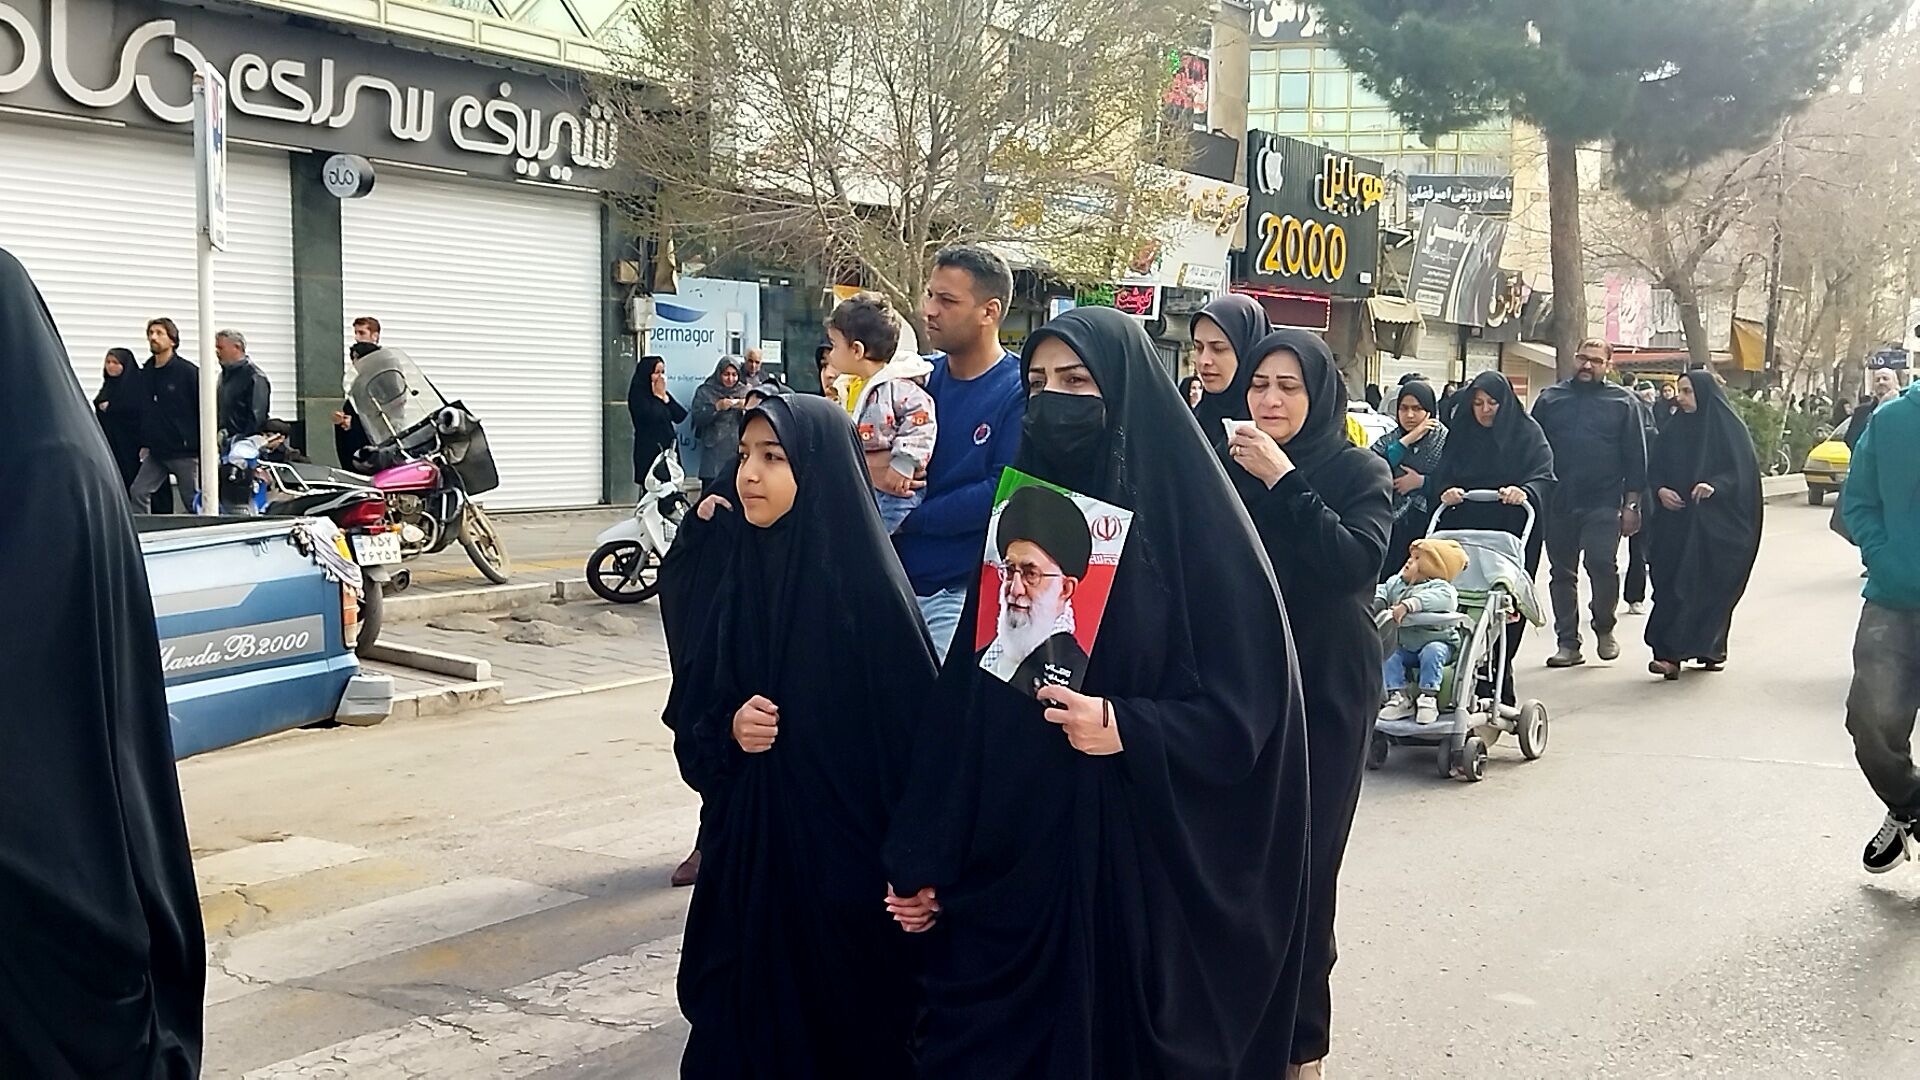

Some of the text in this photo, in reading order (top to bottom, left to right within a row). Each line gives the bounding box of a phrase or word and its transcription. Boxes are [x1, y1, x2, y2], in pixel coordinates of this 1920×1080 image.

[229, 53, 435, 142] سرای
[450, 82, 618, 181] شیرینی
[1315, 153, 1384, 216] موبایل
[1257, 212, 1346, 282] 2000
